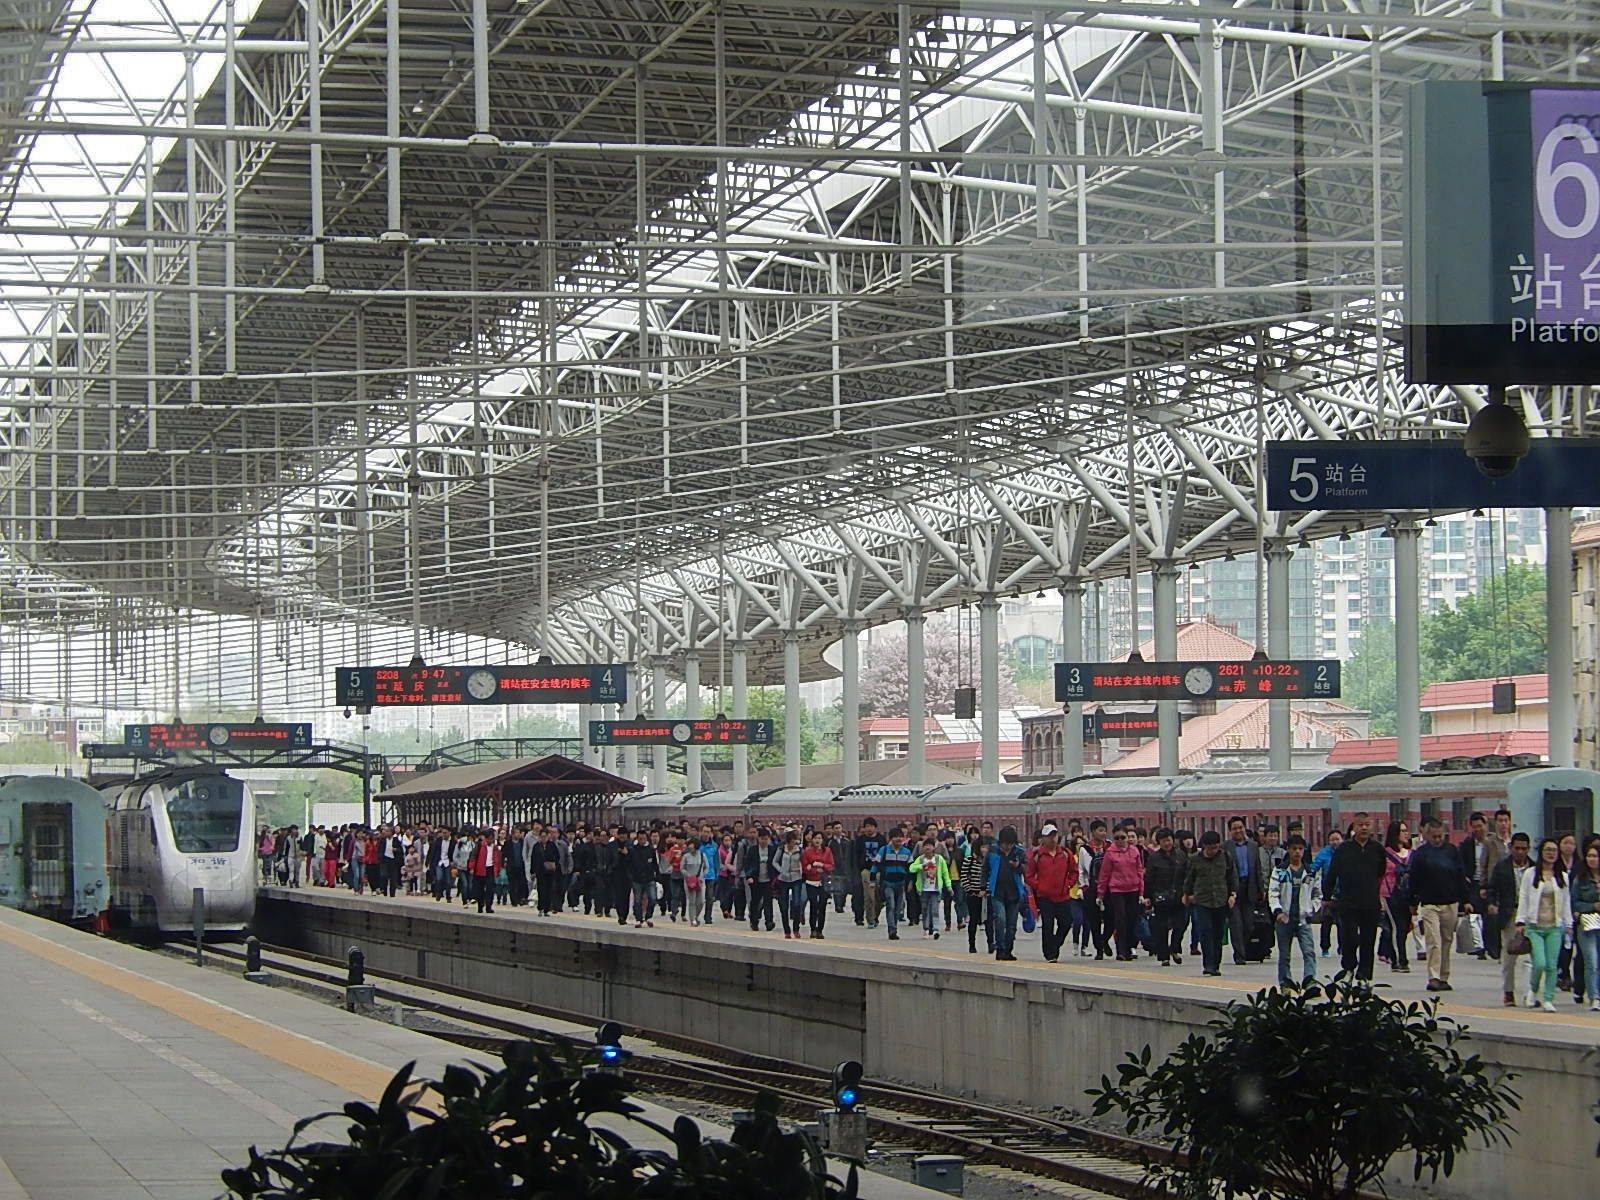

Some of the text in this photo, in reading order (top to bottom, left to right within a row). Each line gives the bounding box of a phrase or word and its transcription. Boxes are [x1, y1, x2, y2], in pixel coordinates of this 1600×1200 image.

[1536, 123, 1600, 238] 6
[1511, 317, 1600, 342] Platfo
[1289, 457, 1318, 502] 5
[1325, 463, 1367, 482] 站台
[1325, 487, 1368, 496] Platform
[376, 670, 399, 679] S208
[421, 669, 445, 679] 9:47
[602, 669, 613, 685] 4
[1070, 667, 1080, 684] 3
[1219, 665, 1244, 676] 2621
[1258, 664, 1291, 676] 10:22
[1317, 665, 1327, 681] 2
[350, 671, 360, 687] 5
[500, 678, 591, 690] 请站在安全线内候车
[133, 727, 141, 738] 5
[296, 726, 304, 737] 4
[598, 723, 606, 735] 3
[757, 722, 765, 733] 2
